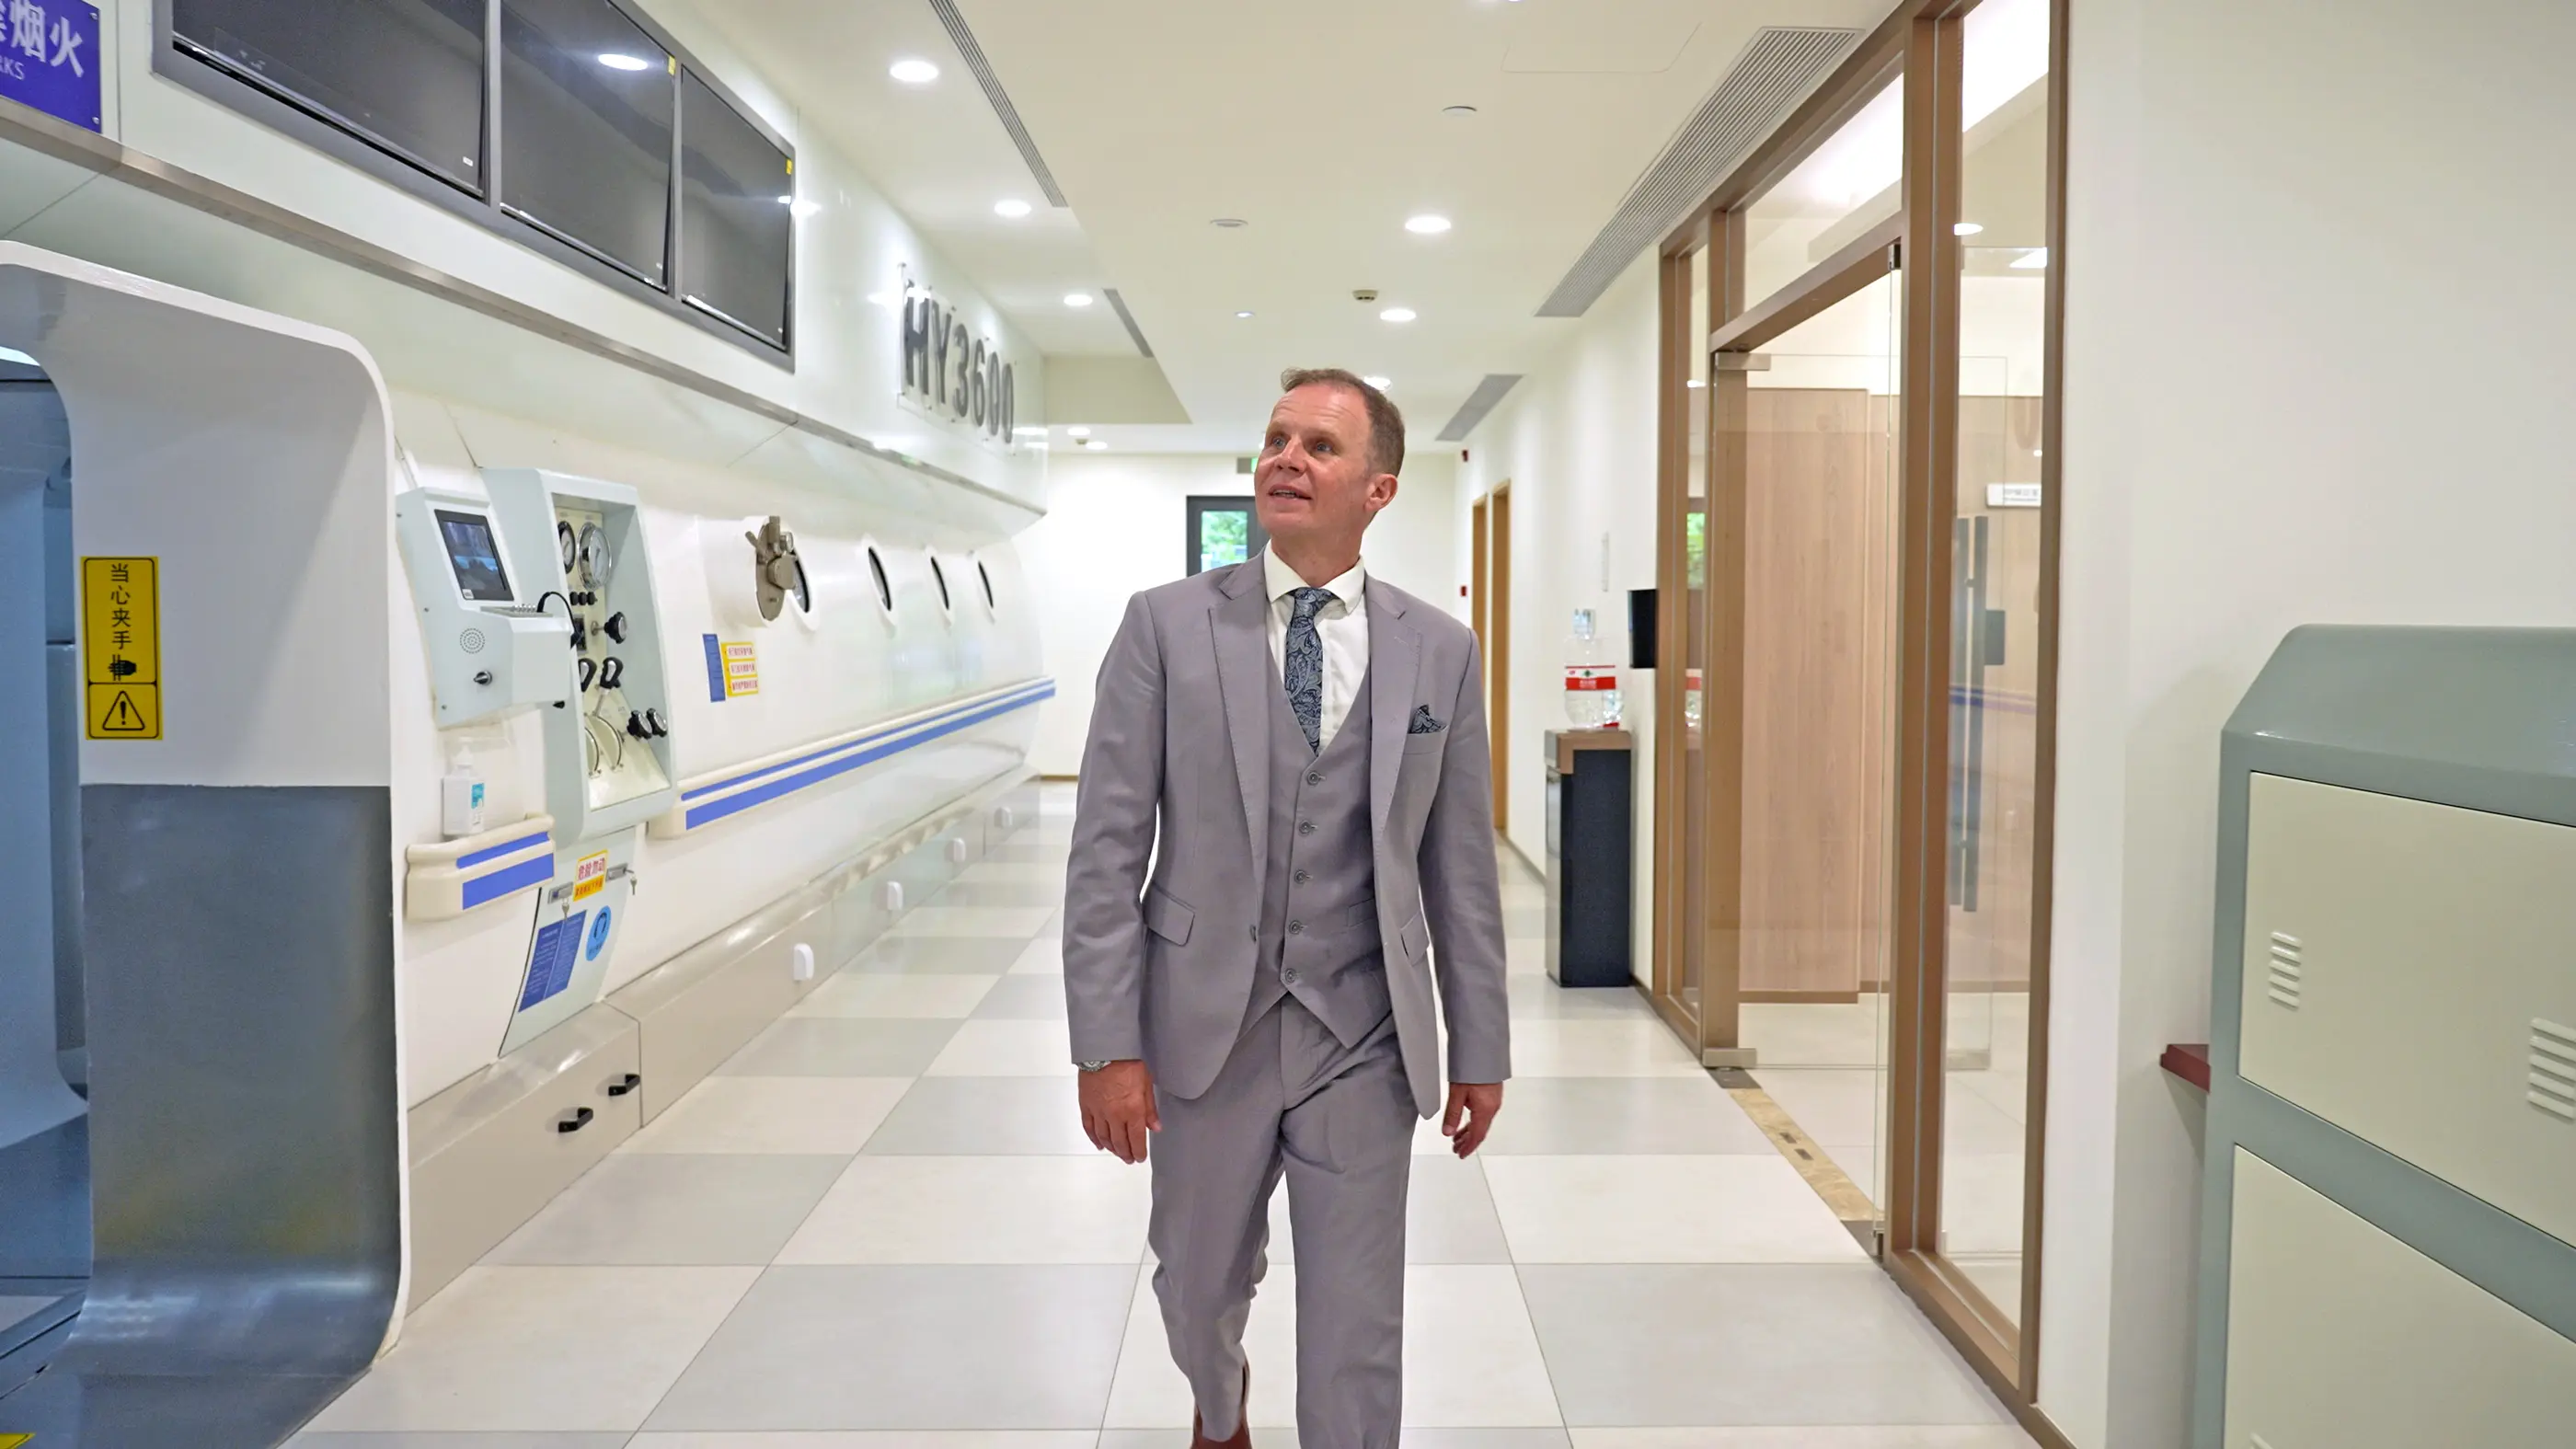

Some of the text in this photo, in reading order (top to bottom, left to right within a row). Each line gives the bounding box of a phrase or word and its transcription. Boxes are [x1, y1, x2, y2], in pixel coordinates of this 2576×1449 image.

[0, 0, 84, 77] 烟火
[0, 55, 25, 80] KS
[903, 279, 1014, 444] HY3600
[110, 563, 132, 650] 当心夹手
